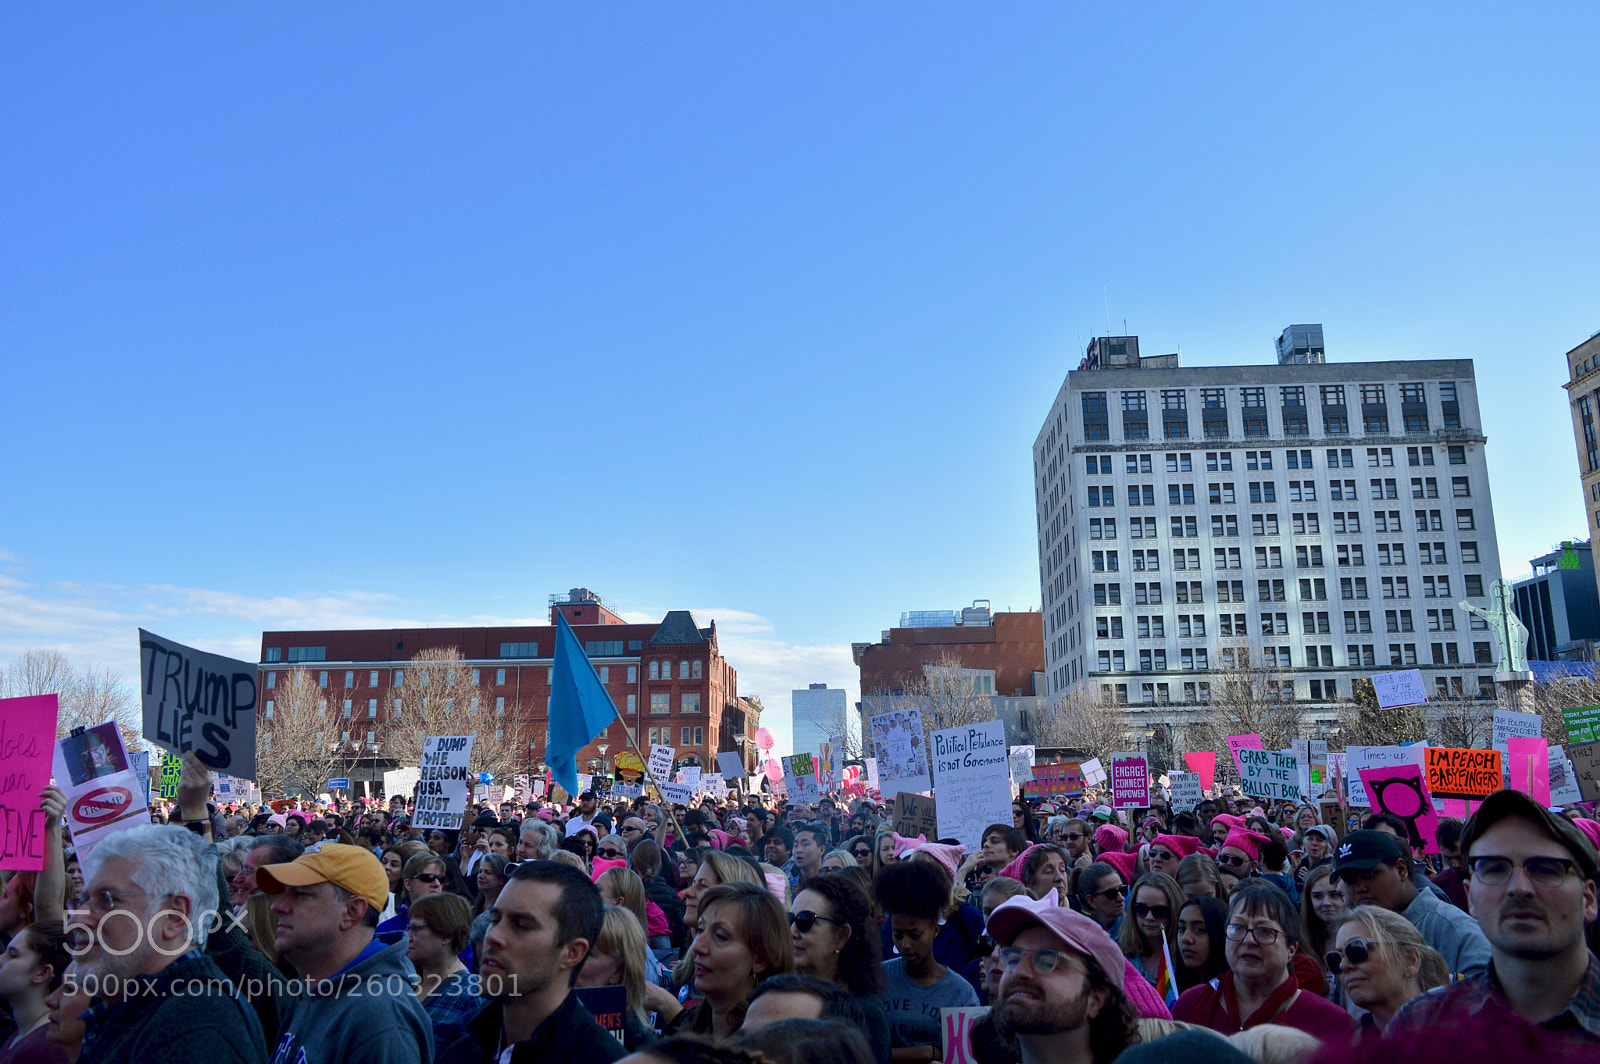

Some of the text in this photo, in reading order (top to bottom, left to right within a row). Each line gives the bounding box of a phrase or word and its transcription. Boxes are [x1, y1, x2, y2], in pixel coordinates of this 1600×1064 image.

[1374, 674, 1395, 686] GRAB
[1508, 717, 1538, 729] POLITICAL
[157, 702, 232, 769] LIES
[437, 738, 467, 751] DUMP
[935, 734, 967, 756] Political
[657, 748, 670, 756] MEN
[1572, 746, 1593, 759] THEY
[938, 752, 1006, 772] is not Governance
[1239, 749, 1270, 766] GRAB
[1272, 753, 1298, 770] THEM
[1429, 749, 1496, 770] IMPEACH
[421, 767, 467, 780] REASON
[1115, 765, 1145, 777] ENGAGE
[1191, 773, 1199, 781] IS
[1248, 766, 1290, 780] BY THE
[1429, 767, 1499, 789] BABYFINGERS
[420, 781, 442, 795] USA
[1024, 765, 1079, 798] ESPECT
[1115, 778, 1145, 788] CONNECT
[1116, 789, 1145, 798] EMPOWER
[1242, 779, 1279, 797] BALLOT
[1281, 784, 1300, 799] BOX
[418, 796, 450, 811] MUST
[415, 811, 463, 828] PROTEST
[922, 1002, 940, 1018] YO
